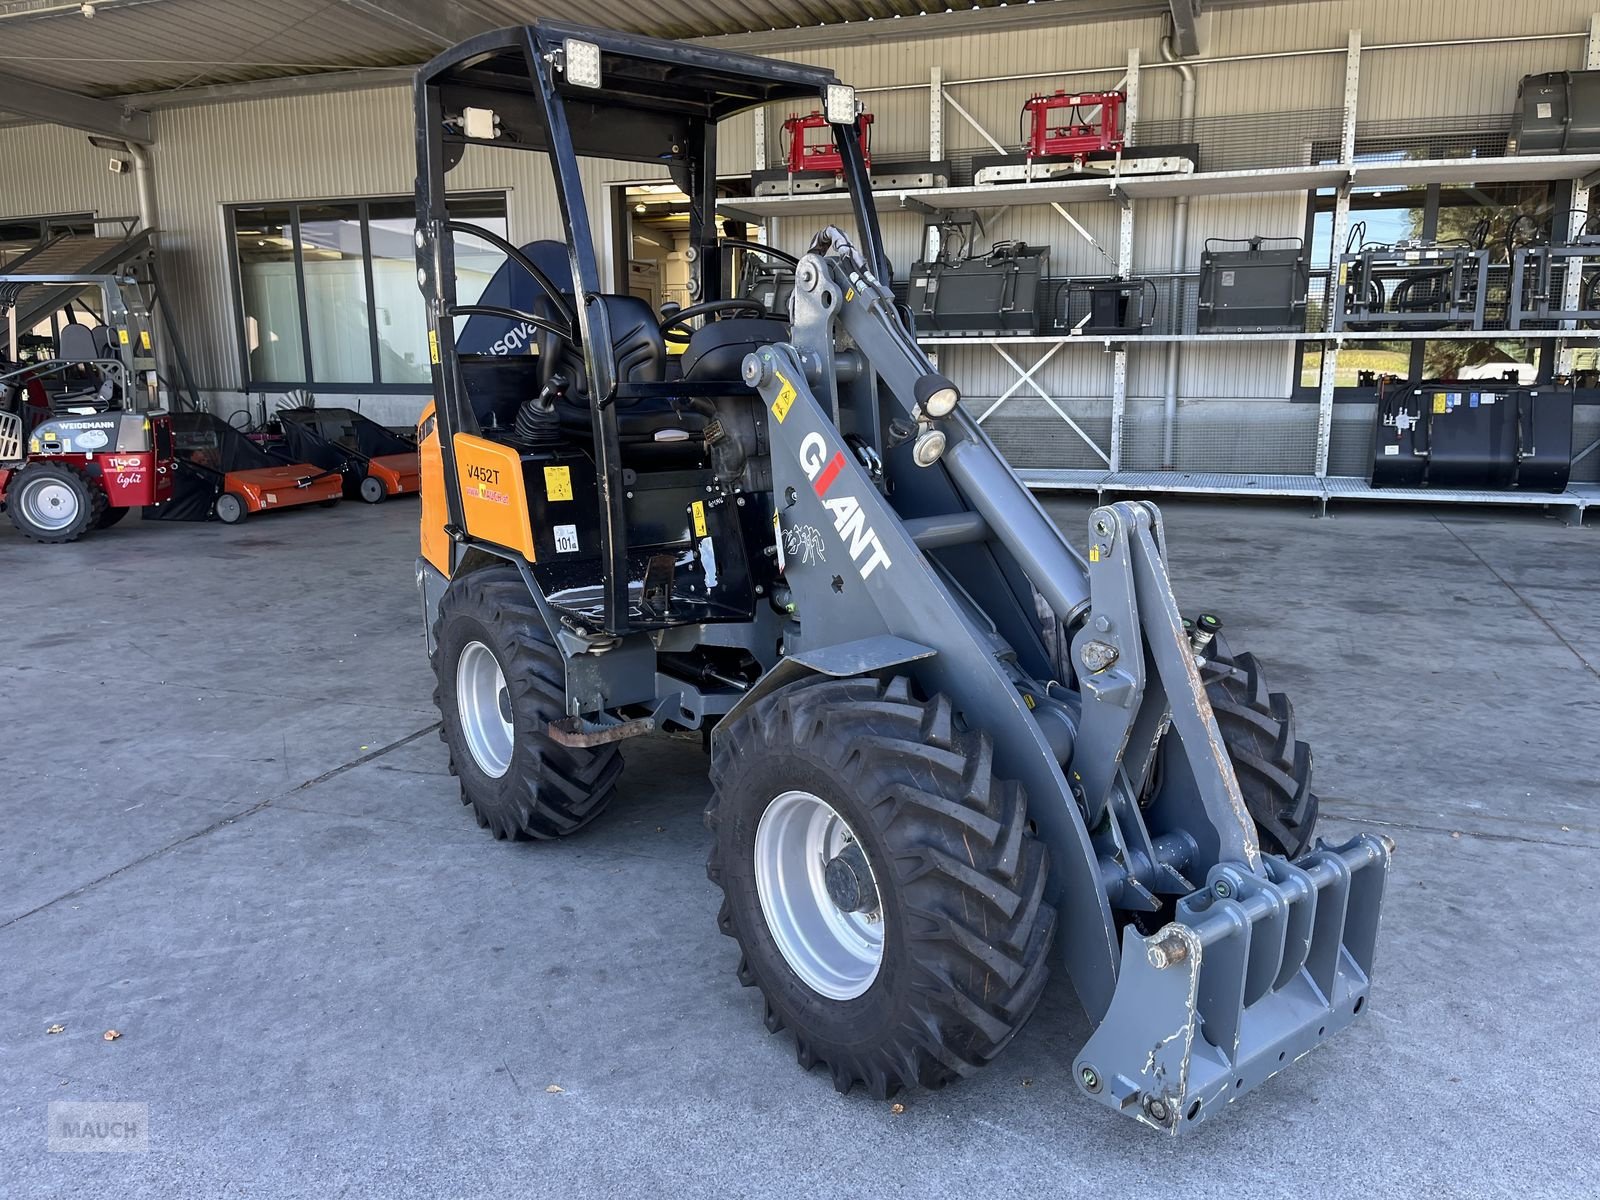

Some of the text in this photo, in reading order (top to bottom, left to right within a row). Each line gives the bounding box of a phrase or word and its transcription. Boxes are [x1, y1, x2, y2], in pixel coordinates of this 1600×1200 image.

[59, 421, 115, 430] WEIDEMANN
[117, 473, 141, 488] light
[466, 464, 500, 485] V452T
[799, 431, 892, 580] GIANT
[556, 536, 572, 551] 101
